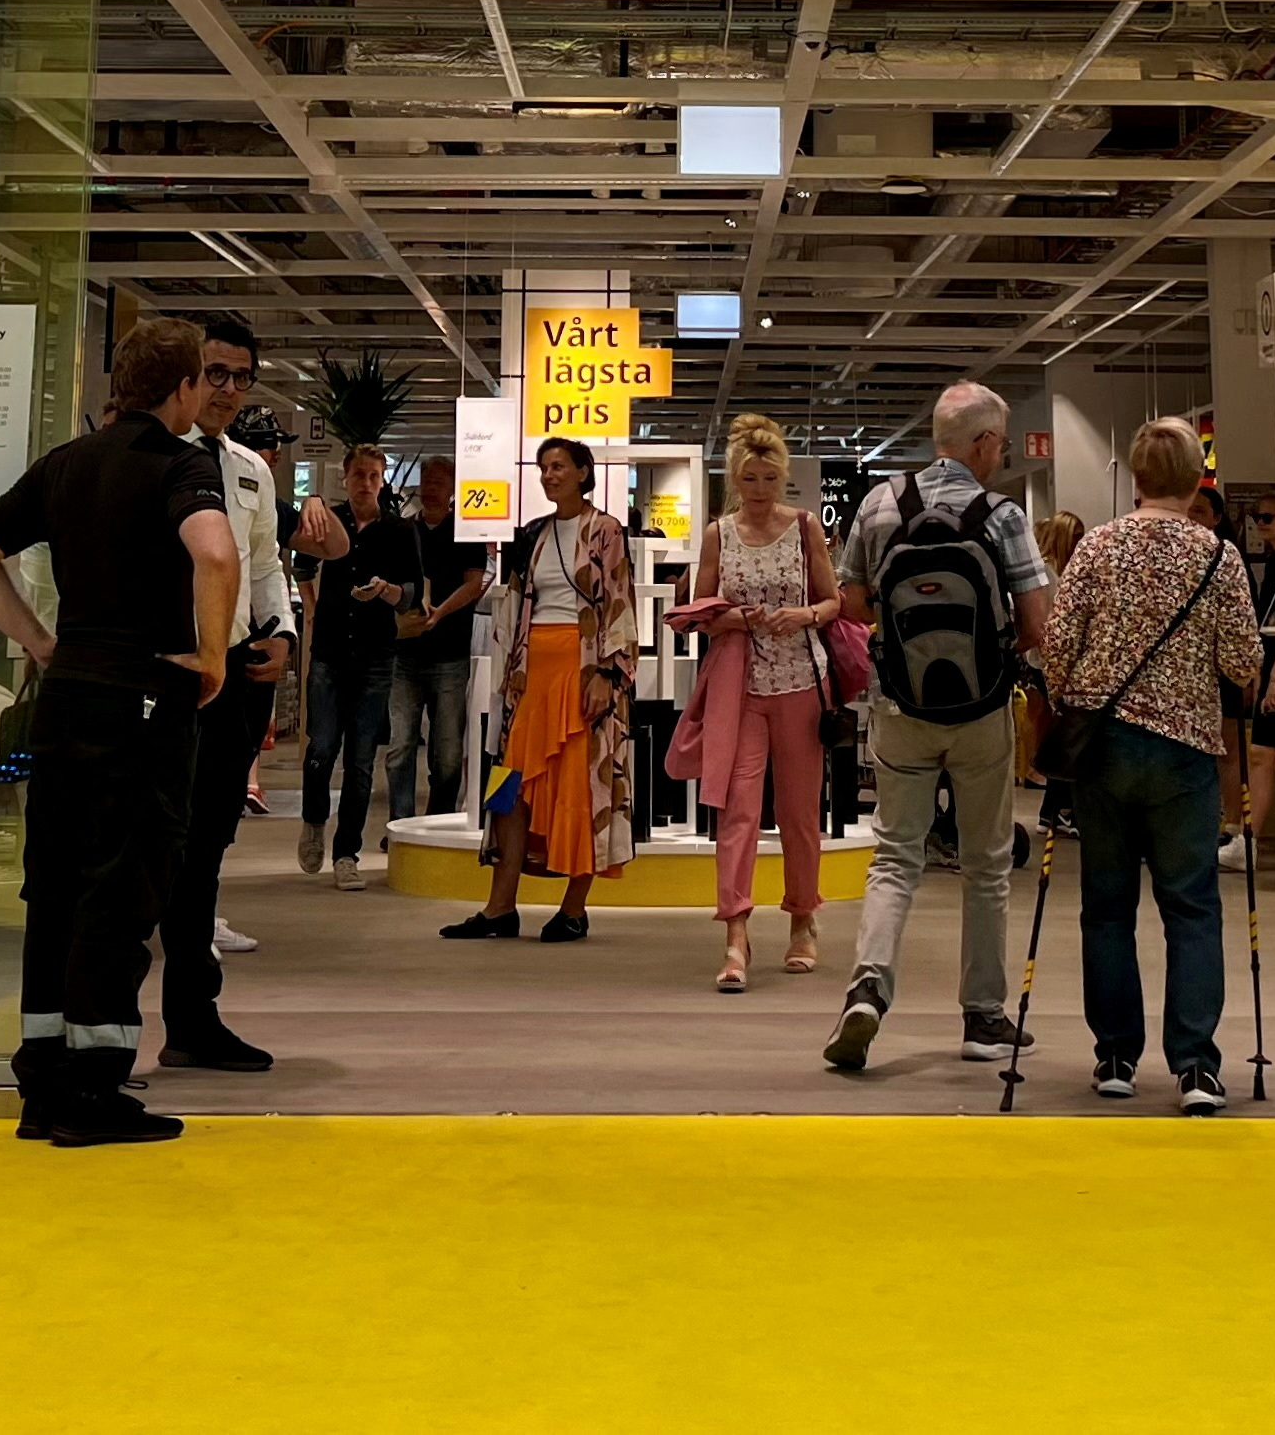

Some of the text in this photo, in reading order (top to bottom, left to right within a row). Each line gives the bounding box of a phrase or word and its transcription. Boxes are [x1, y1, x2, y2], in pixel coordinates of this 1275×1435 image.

[543, 316, 618, 348] Vårt
[545, 355, 651, 392] lägsta
[544, 396, 609, 433] pris
